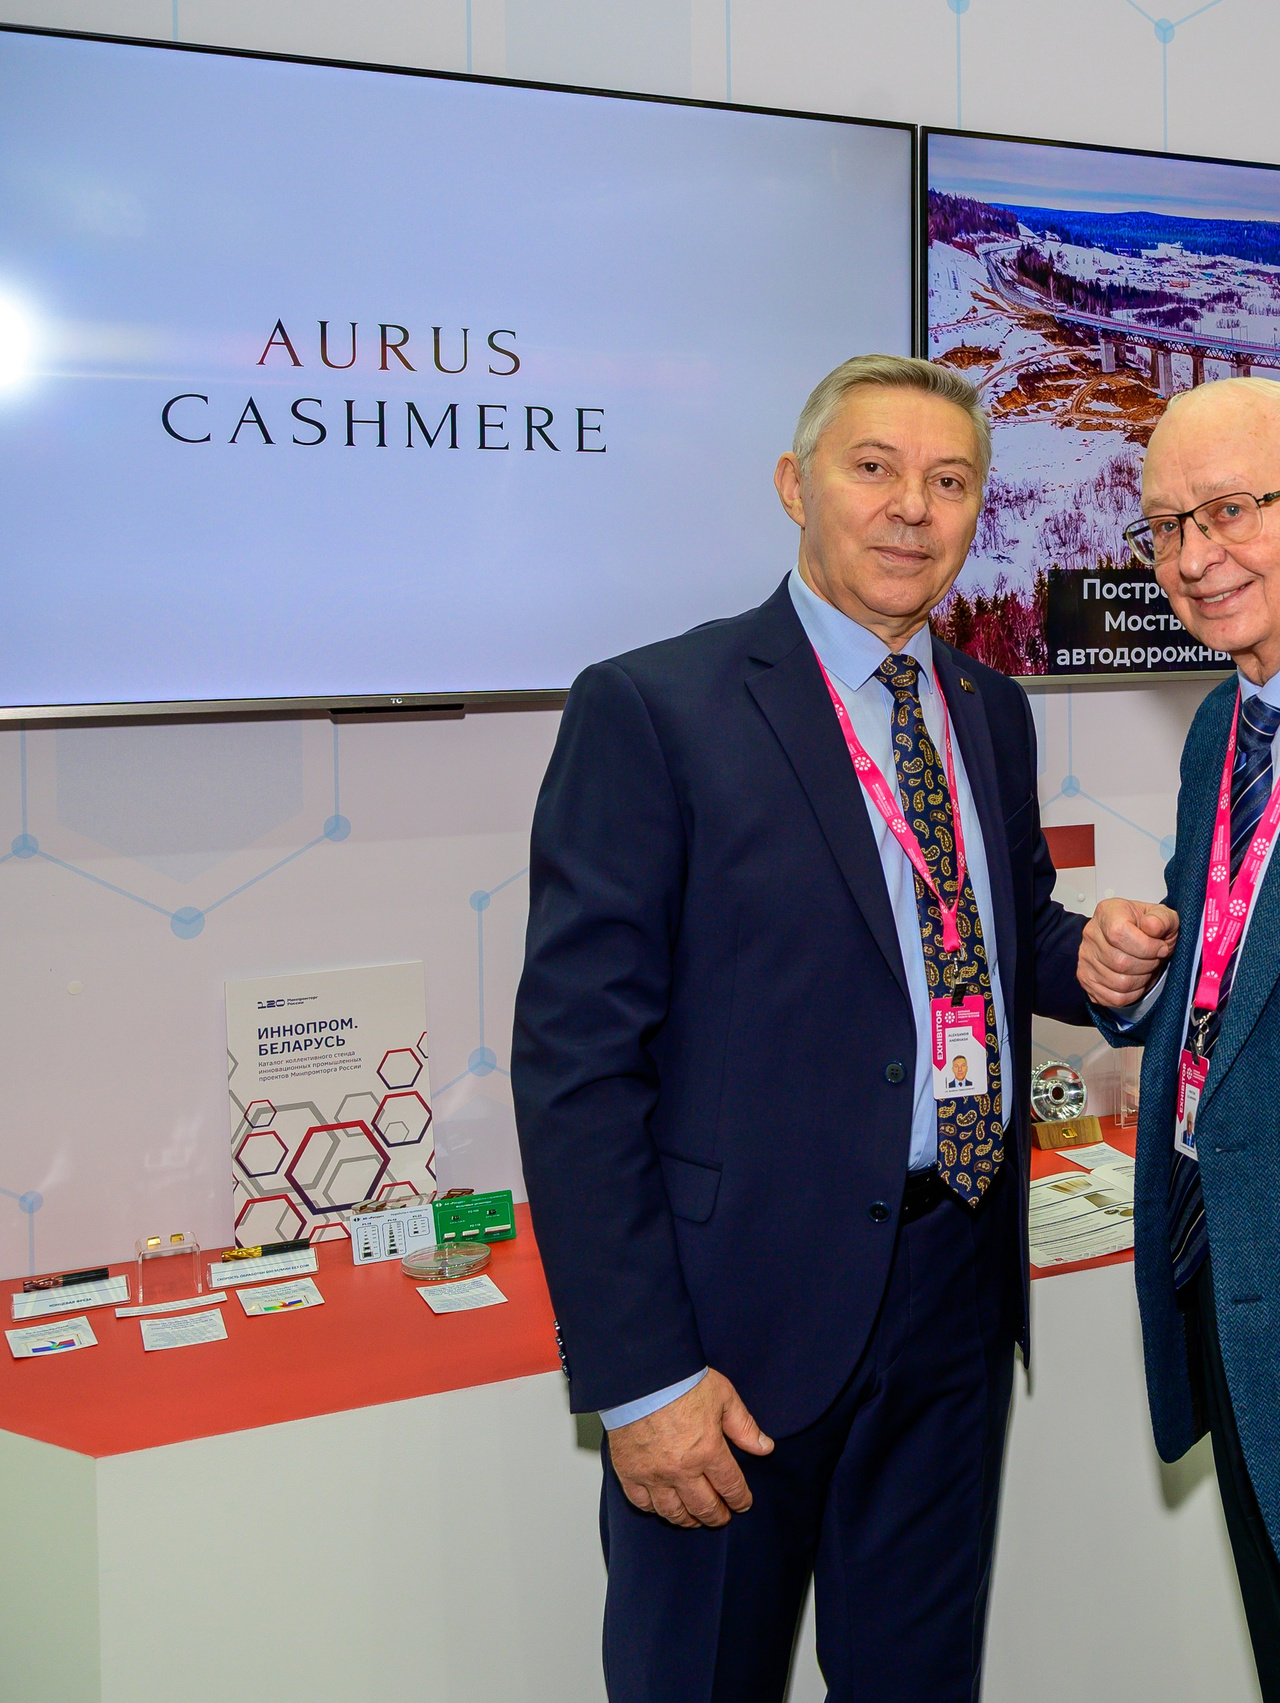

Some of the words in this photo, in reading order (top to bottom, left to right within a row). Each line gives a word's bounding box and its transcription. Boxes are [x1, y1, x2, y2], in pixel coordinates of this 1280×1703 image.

[256, 318, 521, 376] AURUS
[160, 393, 608, 453] CASHMERE
[1056, 645, 1232, 668] автодорожны
[258, 1017, 359, 1040] ИННОПРОМ.
[935, 1010, 944, 1060] EXHIBITOR
[258, 1035, 346, 1056] БЕЛАРУСЬ
[258, 1060, 284, 1068] Каталог
[285, 1054, 333, 1065] коллективного
[258, 1064, 311, 1075] инновационных
[312, 1057, 362, 1069] промышленных
[258, 1074, 289, 1082] проектов
[291, 1067, 338, 1078] Минпромторга
[339, 1064, 362, 1072] России
[1179, 1063, 1187, 1113] EXHIBITOR
